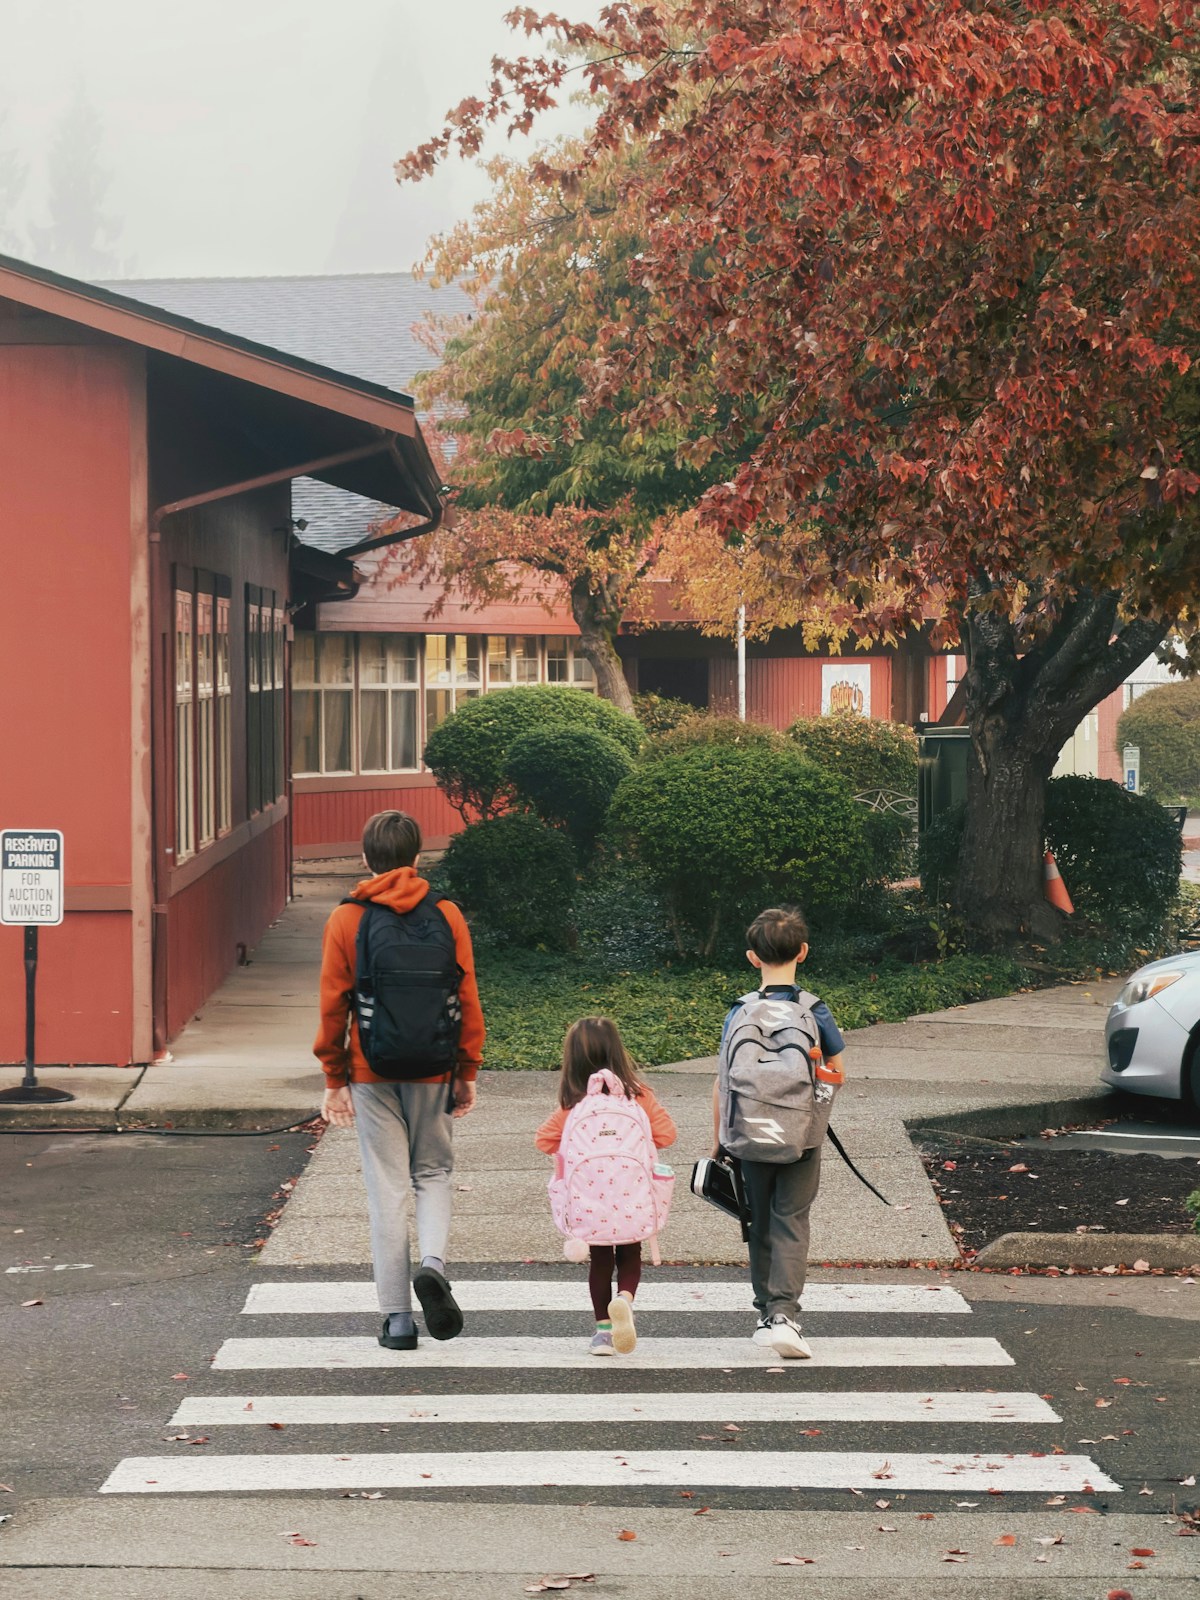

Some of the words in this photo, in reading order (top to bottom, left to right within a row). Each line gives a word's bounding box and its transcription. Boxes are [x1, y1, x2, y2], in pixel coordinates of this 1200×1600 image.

[4, 838, 58, 852] RESERVED
[8, 853, 55, 867] PARKING
[21, 873, 41, 886] FOR
[9, 888, 53, 901] AUCTION
[9, 904, 52, 917] WINNER
